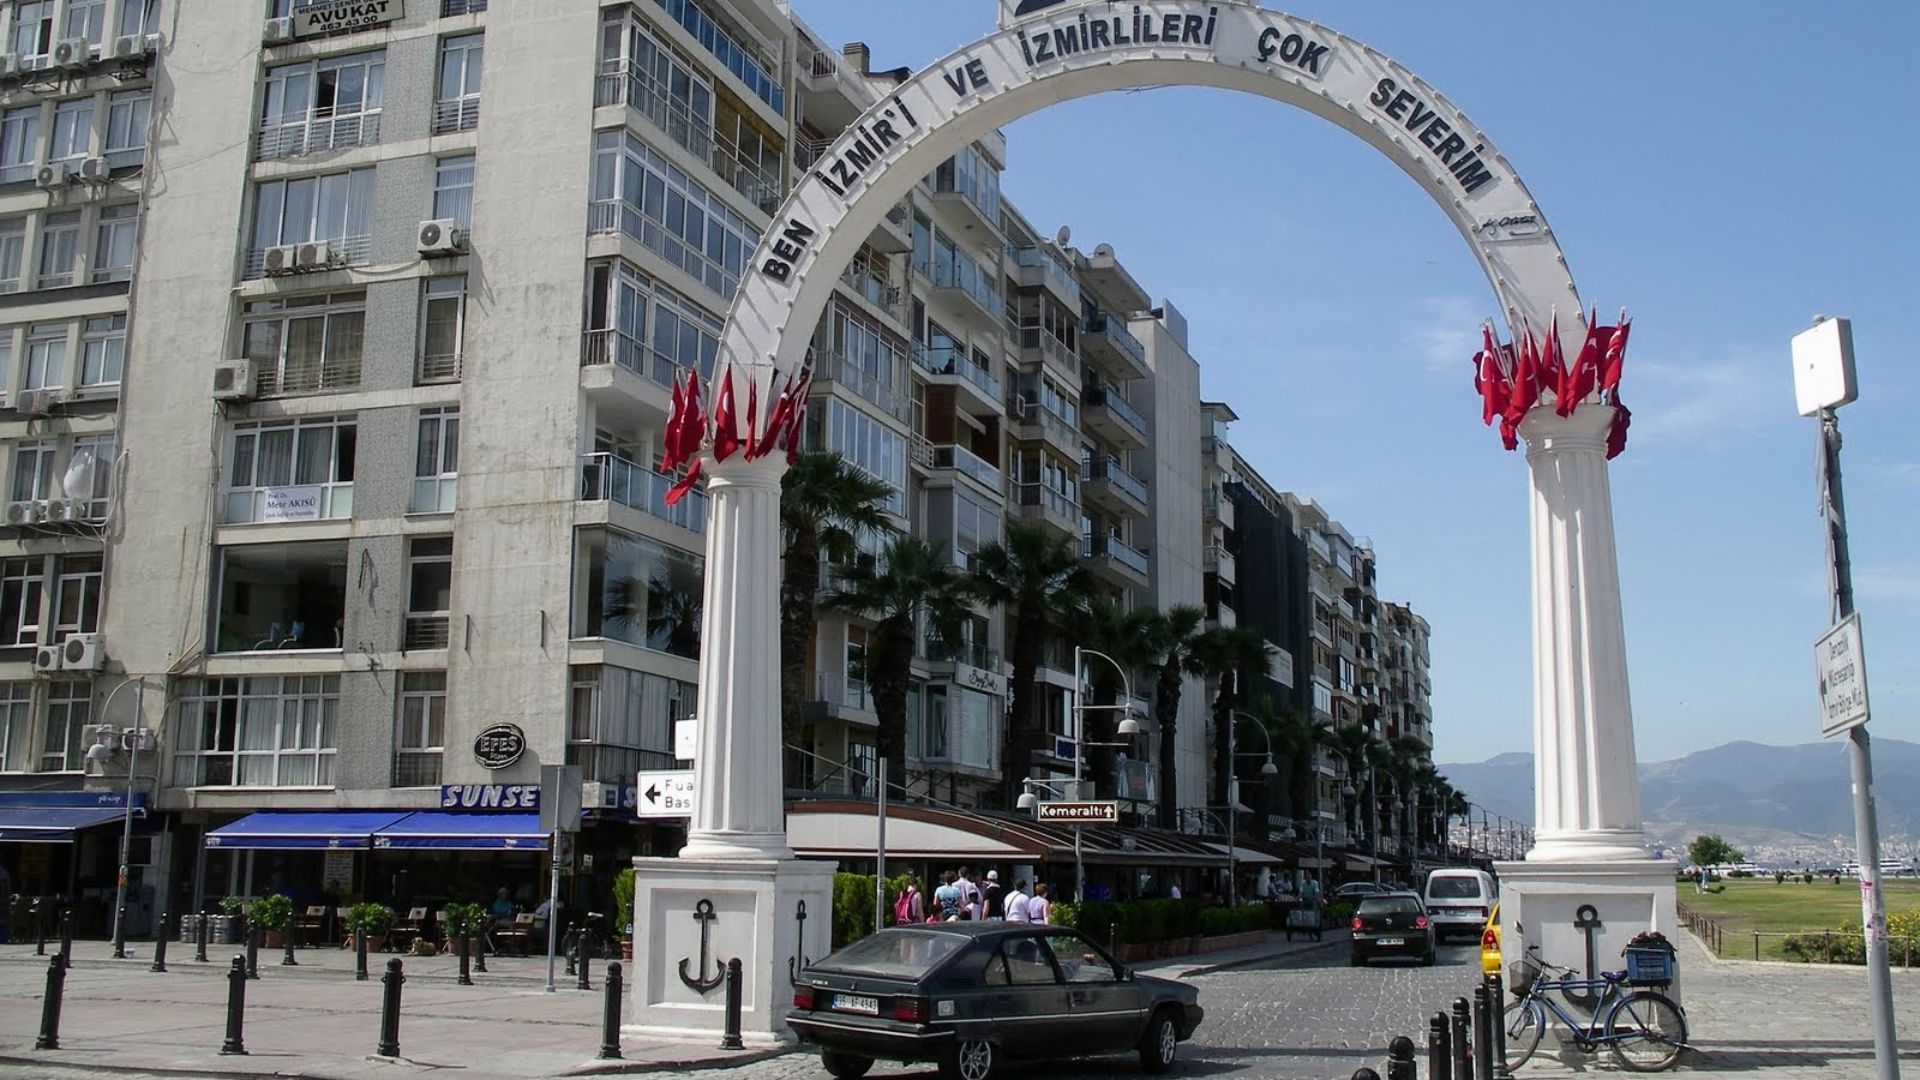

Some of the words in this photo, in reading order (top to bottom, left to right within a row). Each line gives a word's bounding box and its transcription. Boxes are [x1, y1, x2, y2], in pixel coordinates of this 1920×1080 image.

[308, 1, 390, 26] AVUKAT
[320, 22, 342, 31] 463
[345, 19, 360, 27] 43
[363, 15, 378, 24] 00
[762, 218, 814, 282] BEN
[814, 96, 917, 197] İZMİR'İ
[943, 58, 989, 97] VE
[1017, 6, 1218, 67] İZMİRLİLERİ
[1258, 27, 1329, 74] ÇOK
[1370, 78, 1493, 194] SEVERİM
[267, 500, 287, 509] Mete
[480, 736, 518, 752] EFES
[443, 784, 541, 808] SUNSE
[1041, 805, 1103, 817] Kemeraltı
